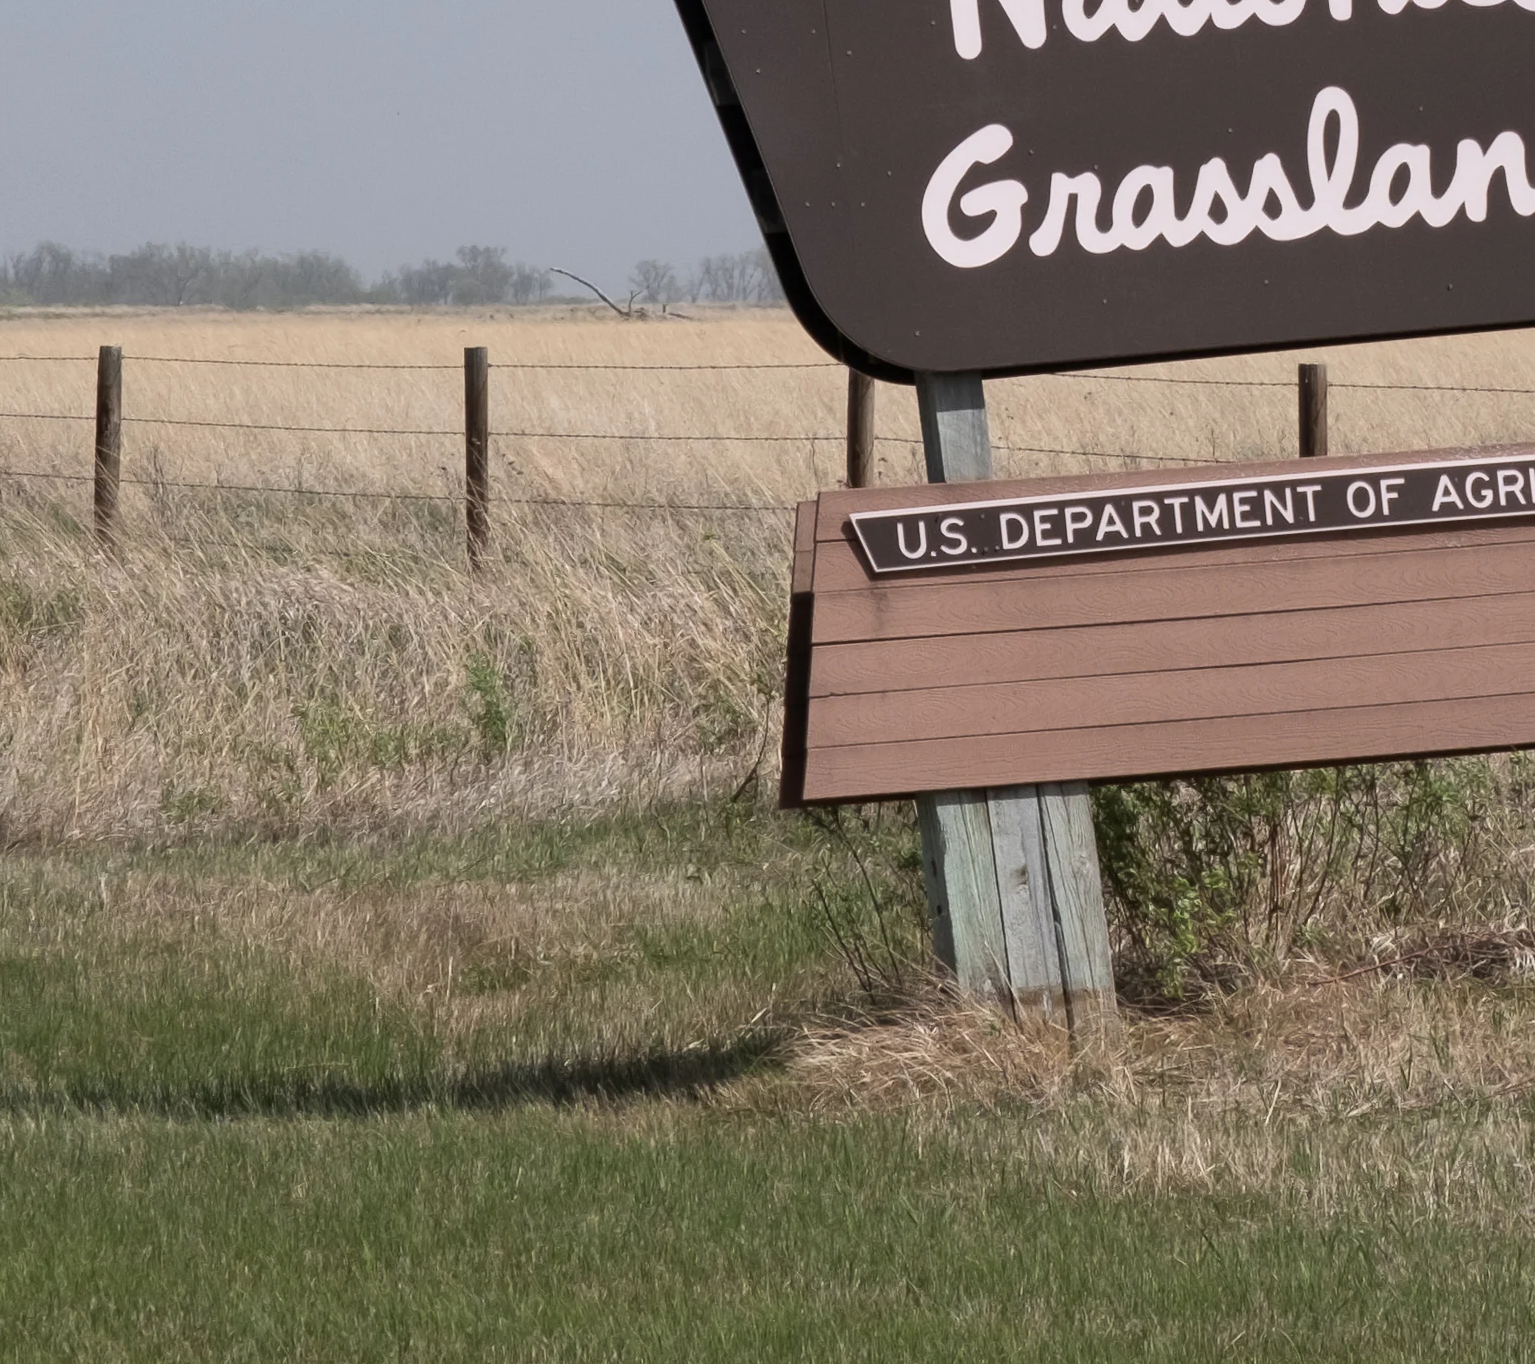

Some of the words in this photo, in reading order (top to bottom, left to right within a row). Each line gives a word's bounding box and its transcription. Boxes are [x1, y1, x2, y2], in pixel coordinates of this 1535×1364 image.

[896, 517, 980, 560] U.S.
[998, 483, 1323, 551] DEPARTMENT
[1345, 477, 1406, 519] OF
